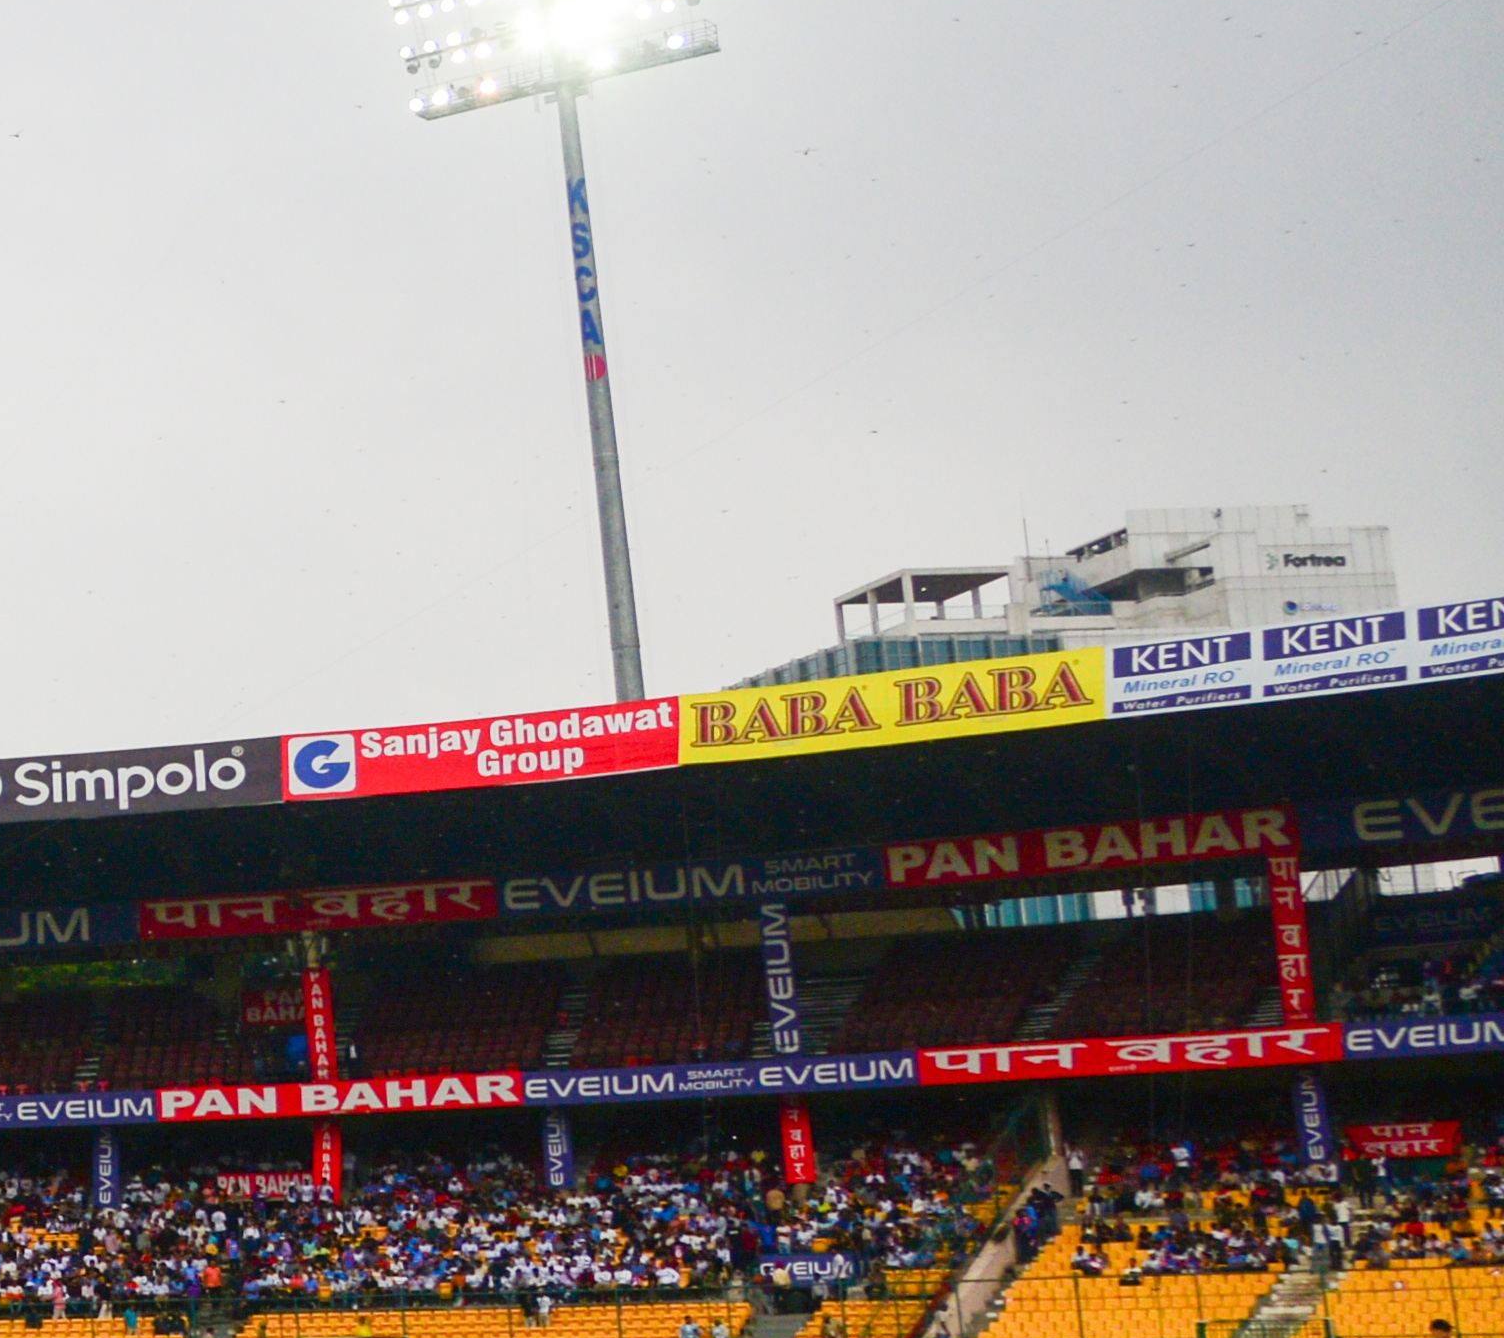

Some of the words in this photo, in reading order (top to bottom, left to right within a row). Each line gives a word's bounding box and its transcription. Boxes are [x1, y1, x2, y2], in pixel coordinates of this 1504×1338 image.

[568, 177, 602, 345] KSCA
[1283, 553, 1346, 568] Fortrea
[1282, 615, 1385, 655] KENT
[1130, 637, 1232, 672] KENT
[1274, 655, 1350, 676] Mineral
[1273, 681, 1320, 696] Water
[1329, 672, 1397, 687] Purifiers
[691, 685, 881, 747] BABA
[894, 661, 1093, 726] BABA
[360, 728, 481, 760] Sanjay
[488, 702, 673, 749] Ghodawat
[476, 744, 585, 778] Group
[765, 854, 855, 873] SMART
[889, 836, 1019, 883] PAN
[1044, 810, 1292, 869] BAHAR
[504, 865, 745, 910] EVEIUM
[752, 870, 874, 895] MOBILITY
[147, 894, 284, 929] पान
[296, 883, 485, 921] बहार
[762, 904, 800, 1054] EVEIUM
[924, 1044, 1087, 1074] पान
[1105, 1028, 1330, 1064] बहार
[526, 1072, 674, 1099] EVEIUM
[679, 1078, 753, 1092] MOBILITY
[686, 1068, 745, 1081] SMART
[759, 1059, 914, 1088] EVEIUM
[17, 1097, 153, 1121] EVEIUM
[159, 1087, 278, 1119] PAN
[299, 1074, 519, 1113] BAHAR
